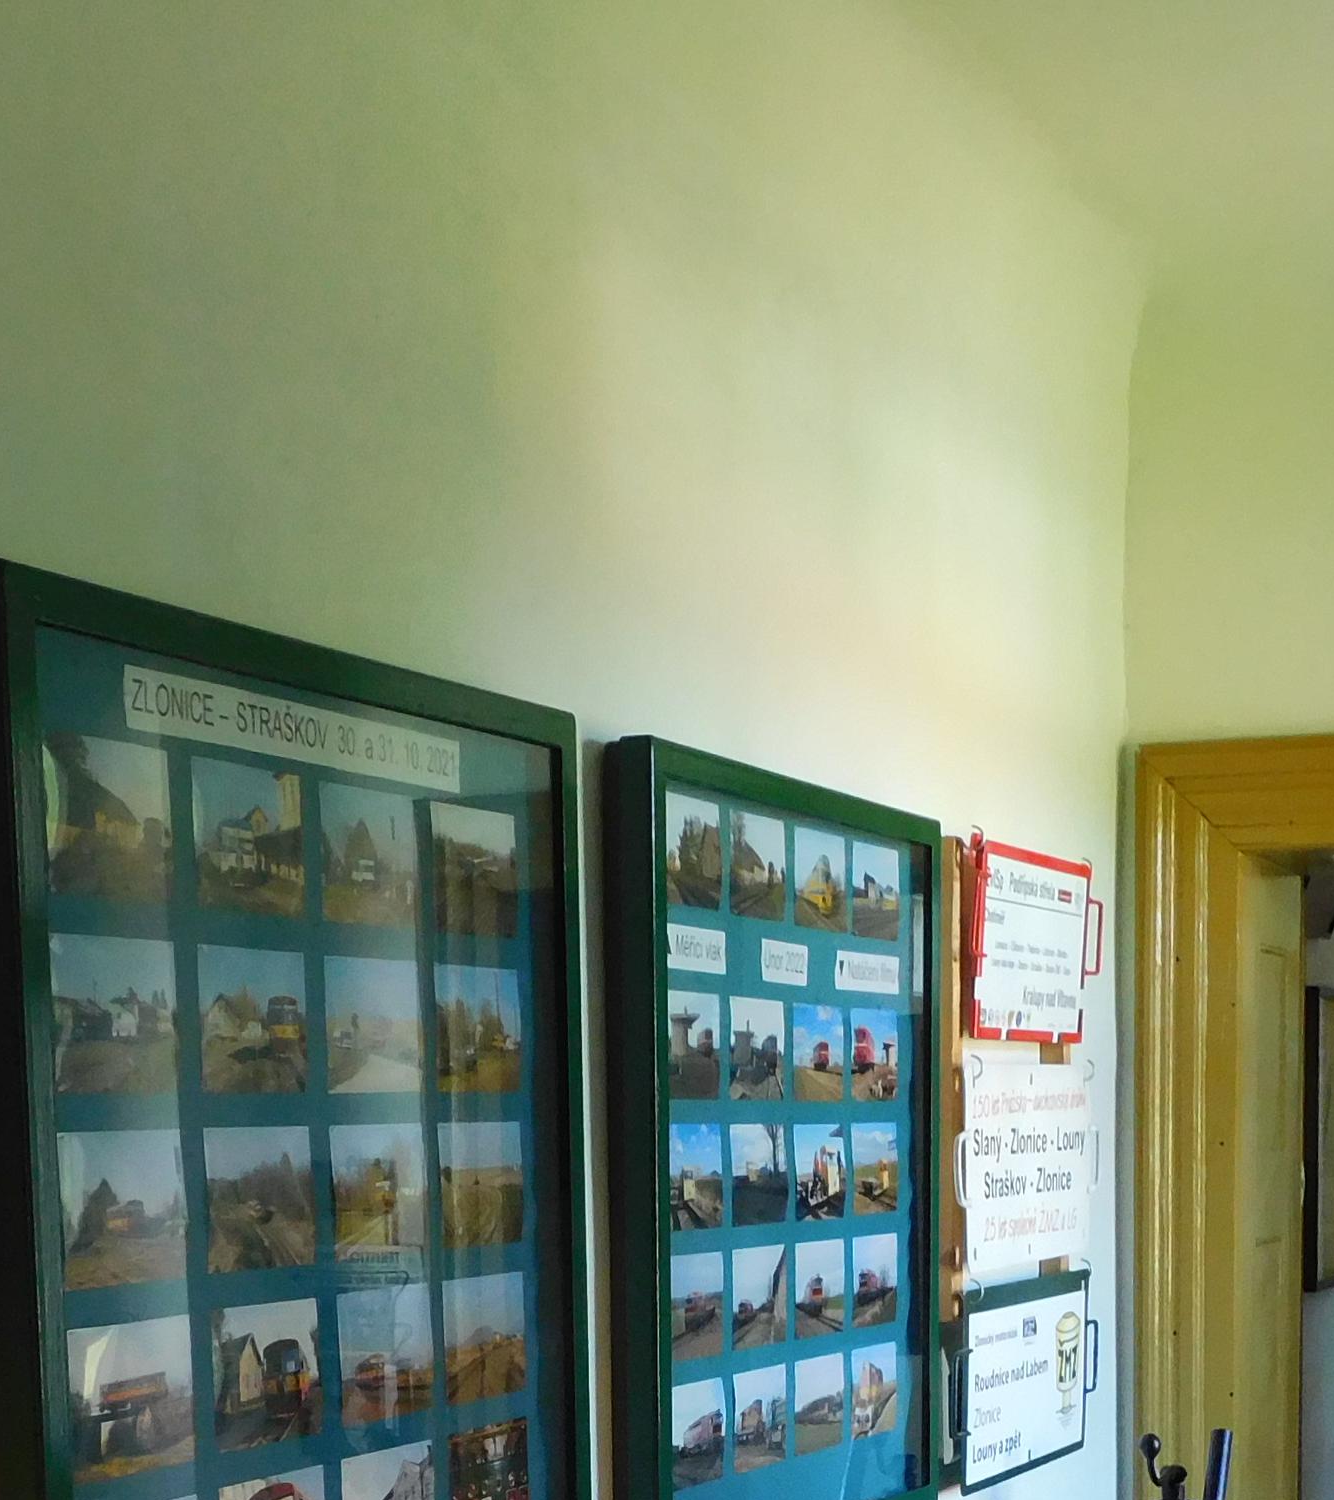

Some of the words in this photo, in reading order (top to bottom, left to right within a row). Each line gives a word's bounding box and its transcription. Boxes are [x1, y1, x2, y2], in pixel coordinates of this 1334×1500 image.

[130, 678, 215, 727] ZLONICE
[236, 702, 329, 750] STRAŠKOV
[427, 748, 456, 778] 2021
[973, 1129, 1001, 1162] Slaný
[1011, 1128, 1047, 1154] Zlonice
[1057, 1127, 1085, 1155] Louny
[984, 1170, 1027, 1199] Straškov
[1036, 1167, 1072, 1193] Zlonice
[974, 1371, 1009, 1392] Roudnice
[1011, 1365, 1024, 1381] nad
[1025, 1359, 1048, 1378] Labem
[972, 1439, 997, 1464] Louny
